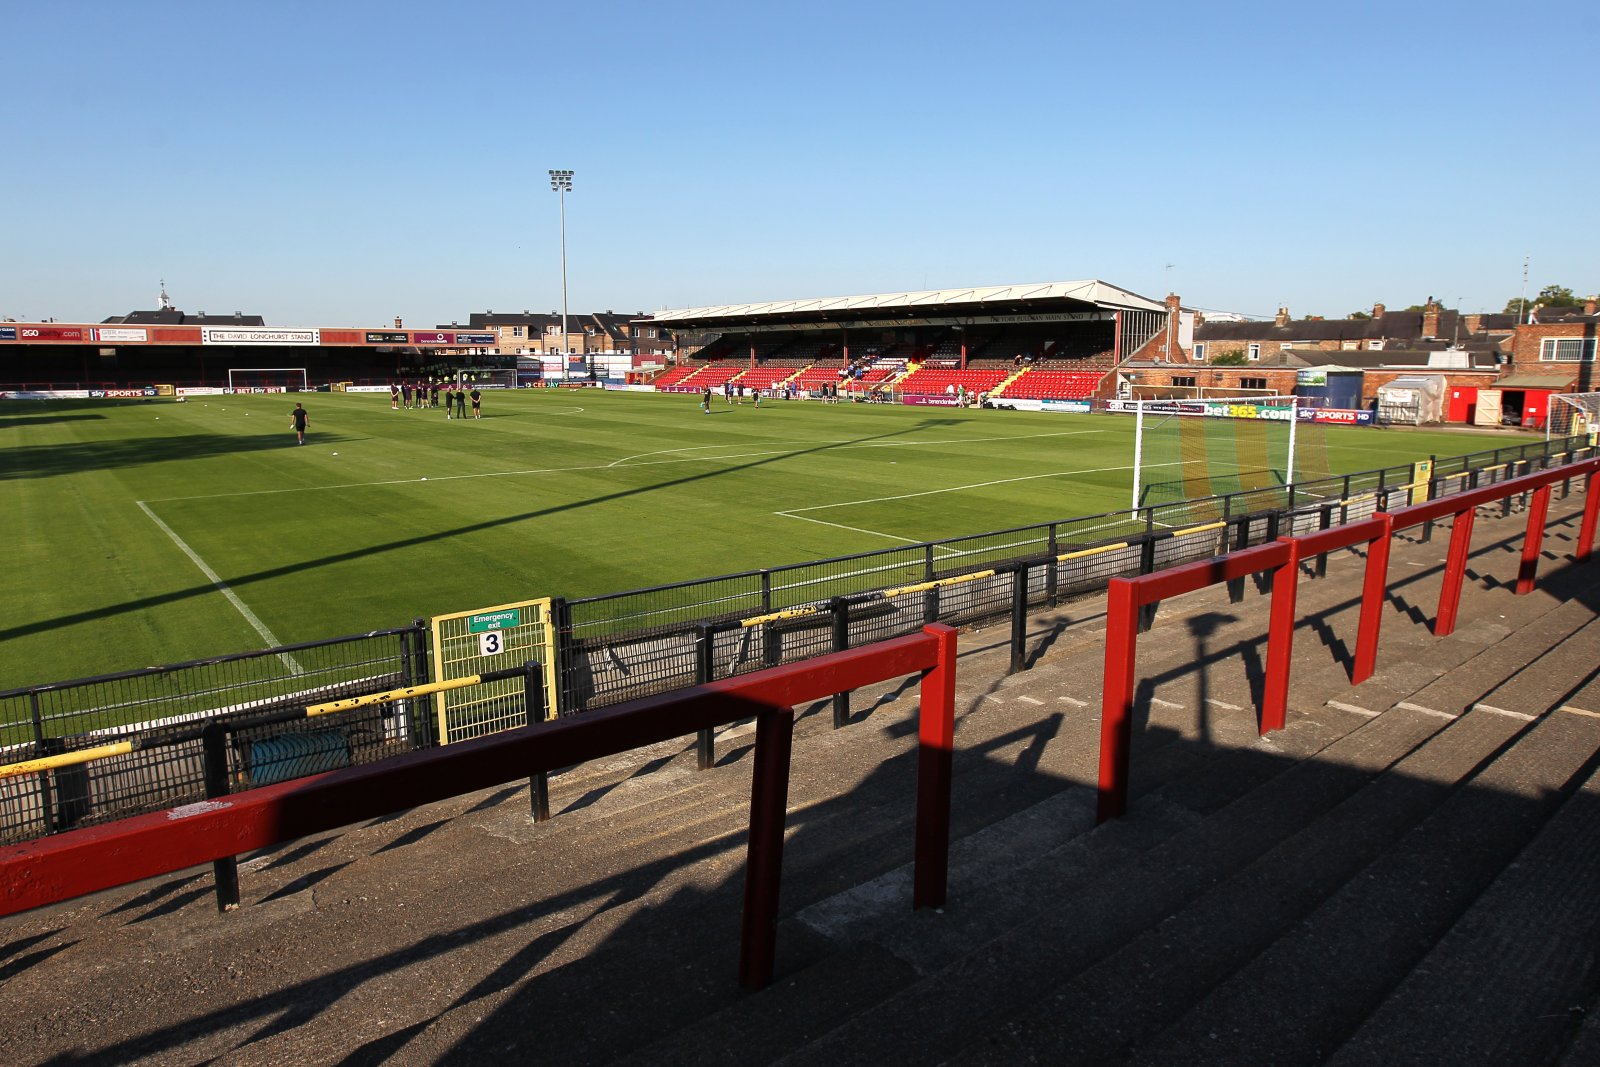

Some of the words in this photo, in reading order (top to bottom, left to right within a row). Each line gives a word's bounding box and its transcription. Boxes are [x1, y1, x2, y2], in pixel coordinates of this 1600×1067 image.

[1204, 404, 1293, 420] bet365.com
[1300, 411, 1314, 419] sky
[1316, 411, 1354, 420] SPORTS
[474, 613, 513, 622] Emergency
[486, 634, 499, 653] 3
